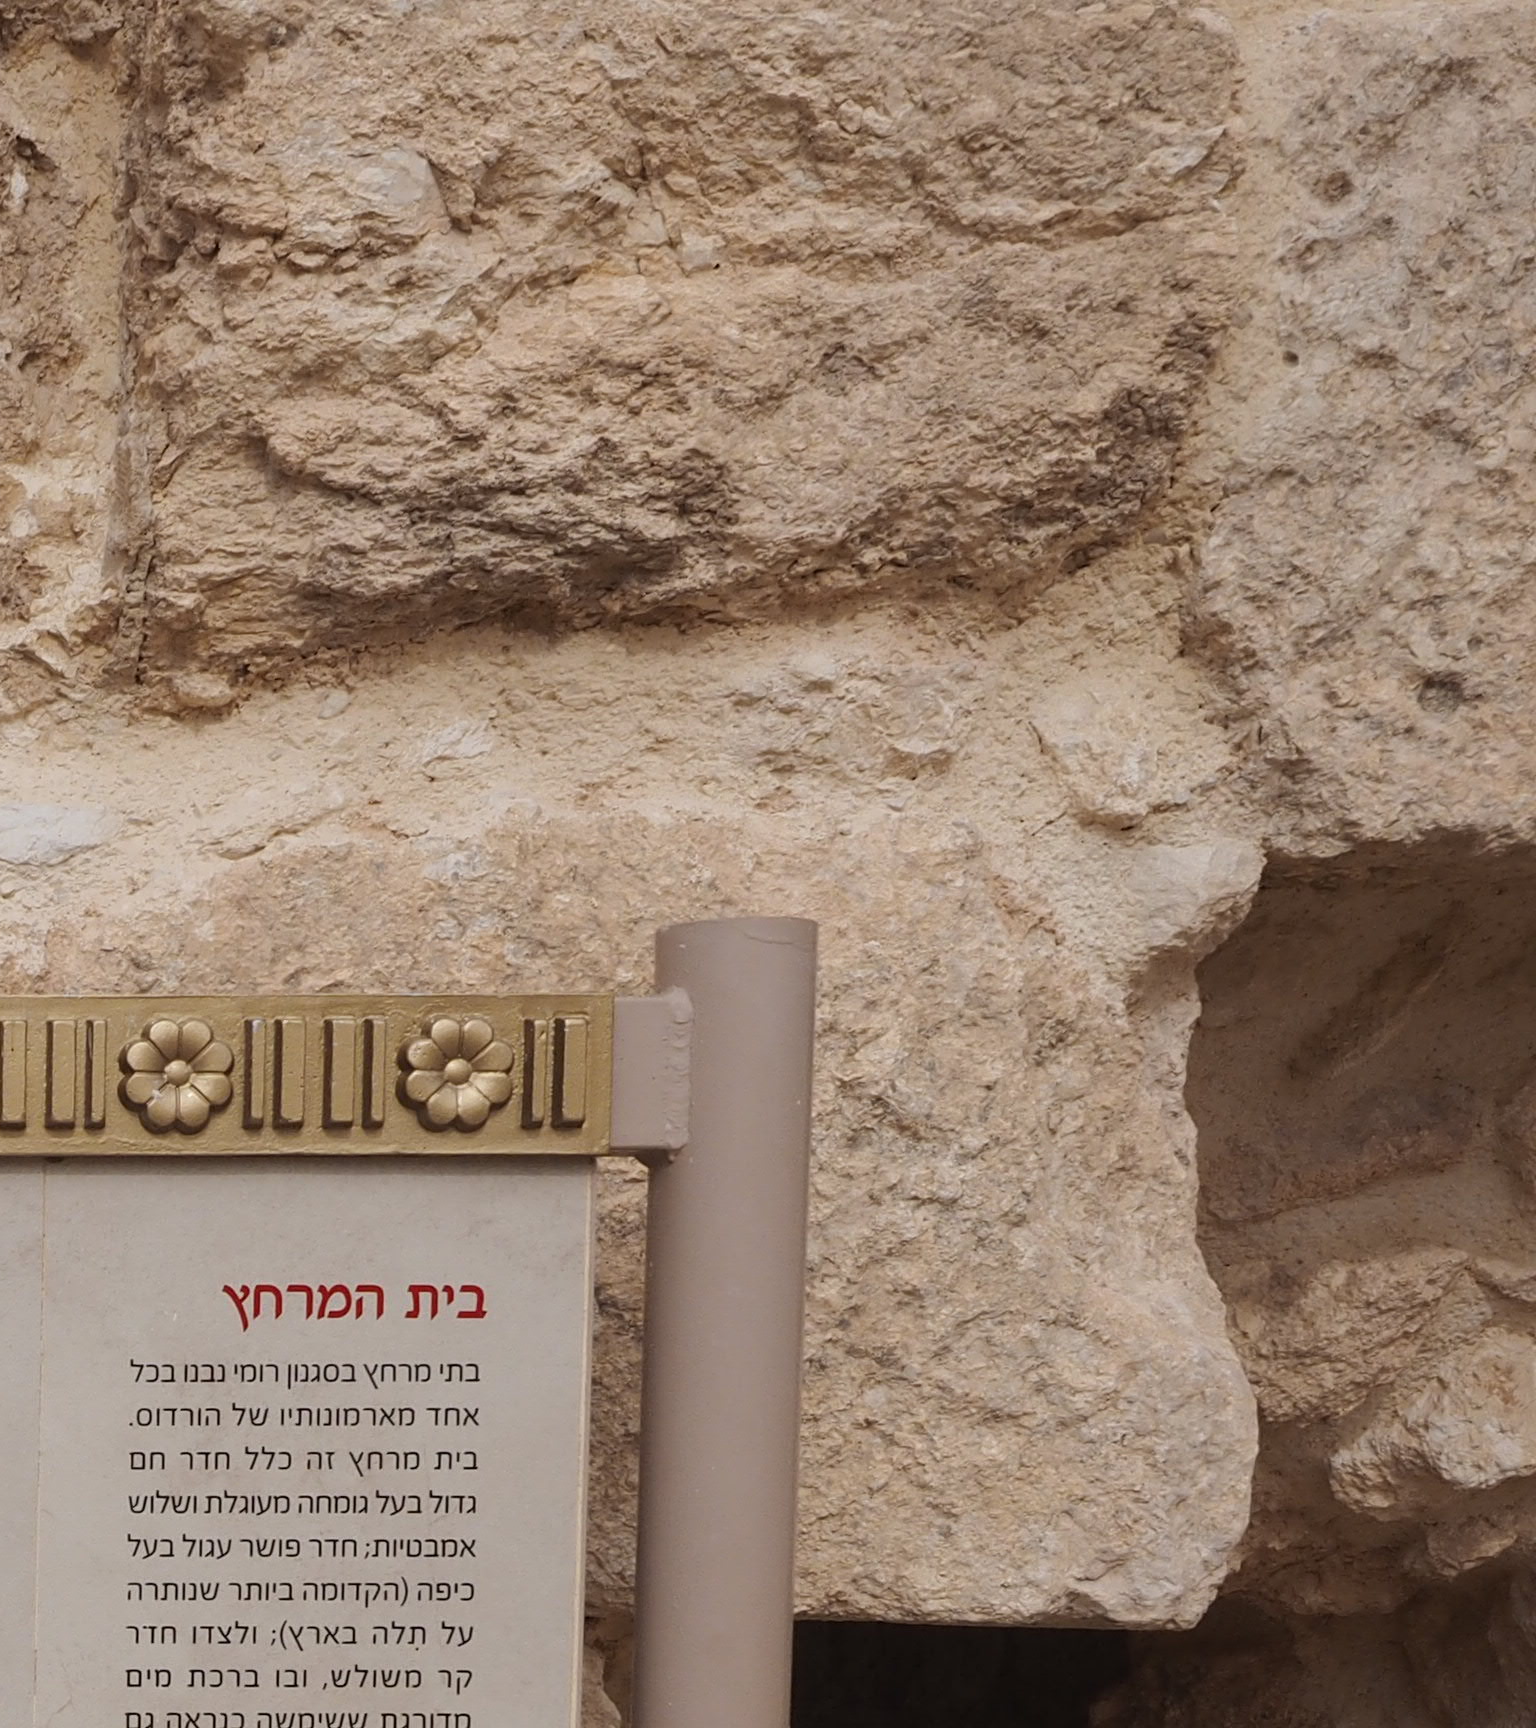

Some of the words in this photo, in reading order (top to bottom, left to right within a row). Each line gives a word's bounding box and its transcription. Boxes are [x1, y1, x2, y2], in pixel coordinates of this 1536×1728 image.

[222, 1284, 384, 1332] המרחץ
[404, 1284, 488, 1320] בית
[130, 1359, 176, 1383] בכל
[184, 1364, 226, 1383] נבנו
[234, 1364, 279, 1383] רומי
[287, 1364, 357, 1390] בסגנון
[363, 1364, 431, 1390] מרחץ
[440, 1363, 480, 1382] בתי
[129, 1408, 221, 1427] הורדוס.
[232, 1402, 269, 1426] של
[280, 1407, 415, 1426] מארמונותיו
[426, 1407, 479, 1426] אחד
[129, 1452, 165, 1470] חם
[180, 1452, 230, 1470] חדר
[245, 1446, 292, 1470] כלל
[307, 1451, 335, 1470] זה
[349, 1451, 420, 1477] מרחץ
[434, 1451, 478, 1470] בית
